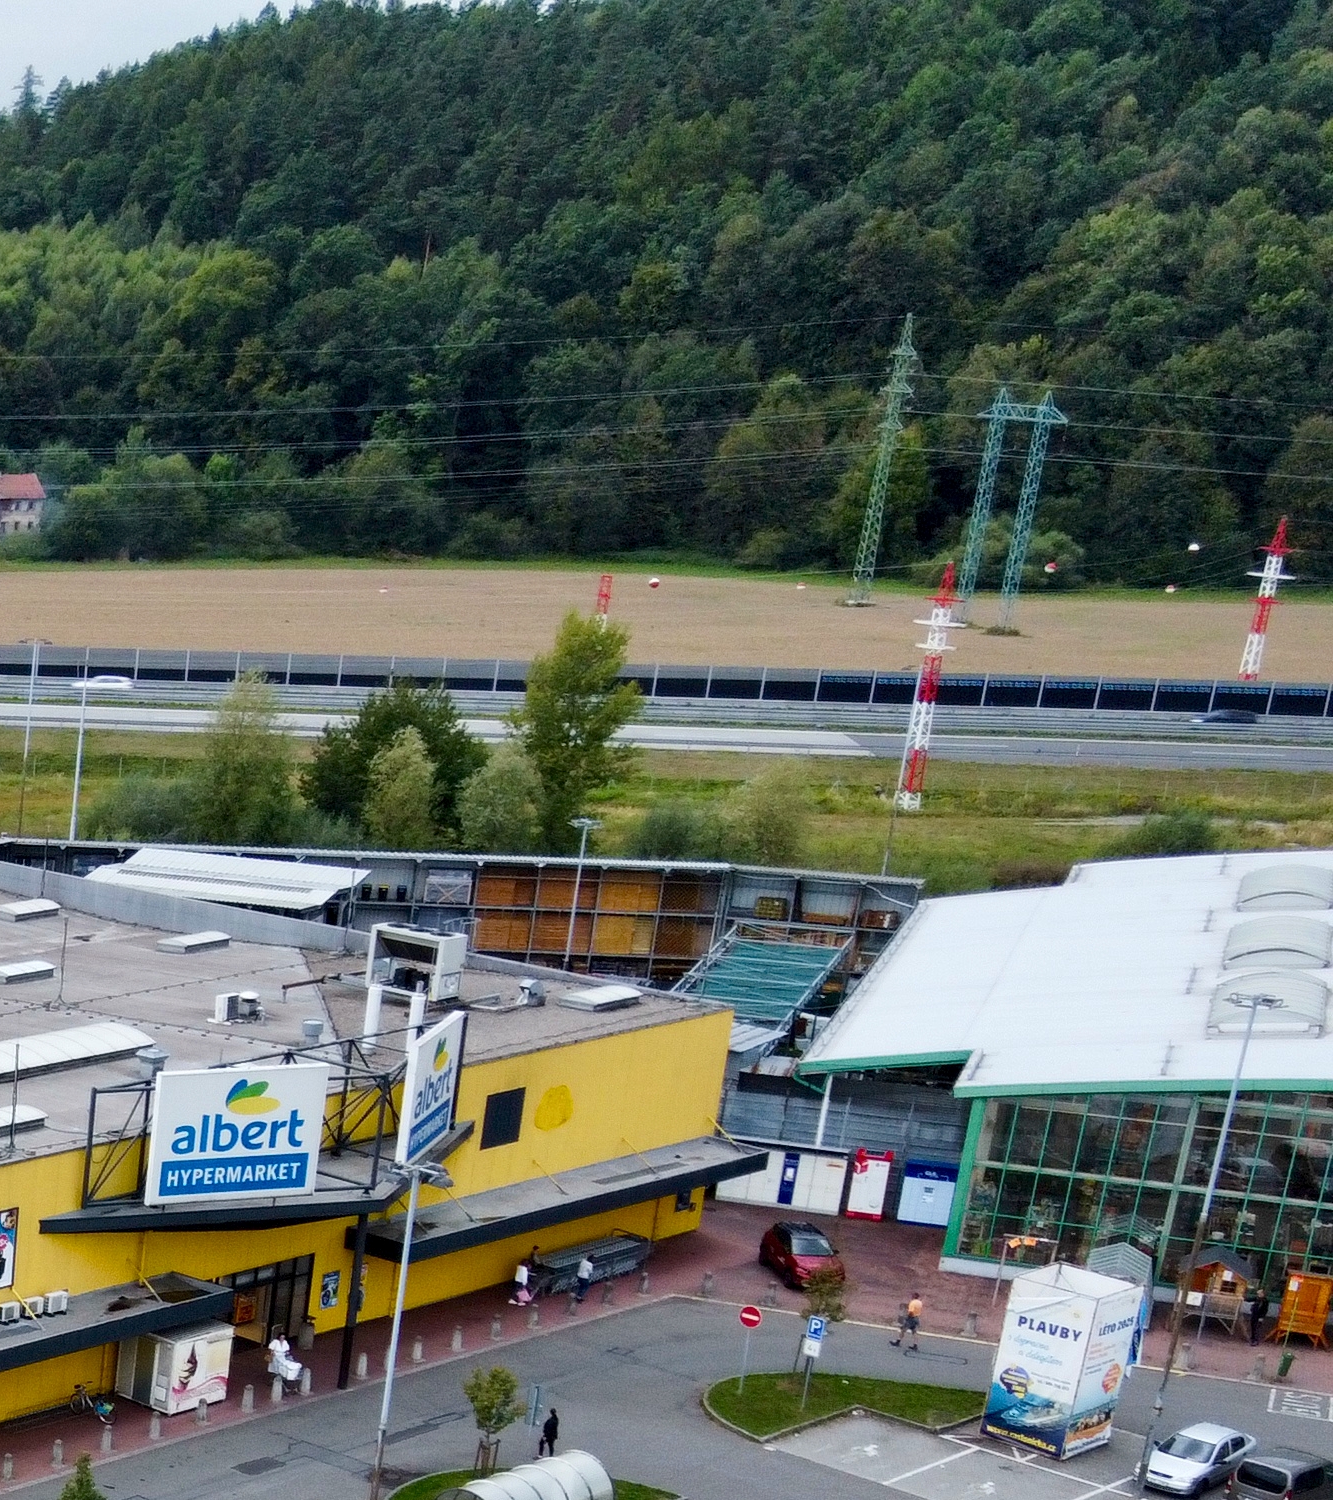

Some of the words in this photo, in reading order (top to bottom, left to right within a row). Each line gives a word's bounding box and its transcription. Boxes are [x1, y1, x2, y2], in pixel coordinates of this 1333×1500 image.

[414, 1059, 452, 1120] albert
[171, 1109, 305, 1155] albert
[167, 1162, 301, 1188] HYPERMARKET
[1017, 1315, 1082, 1343] PLAVBY
